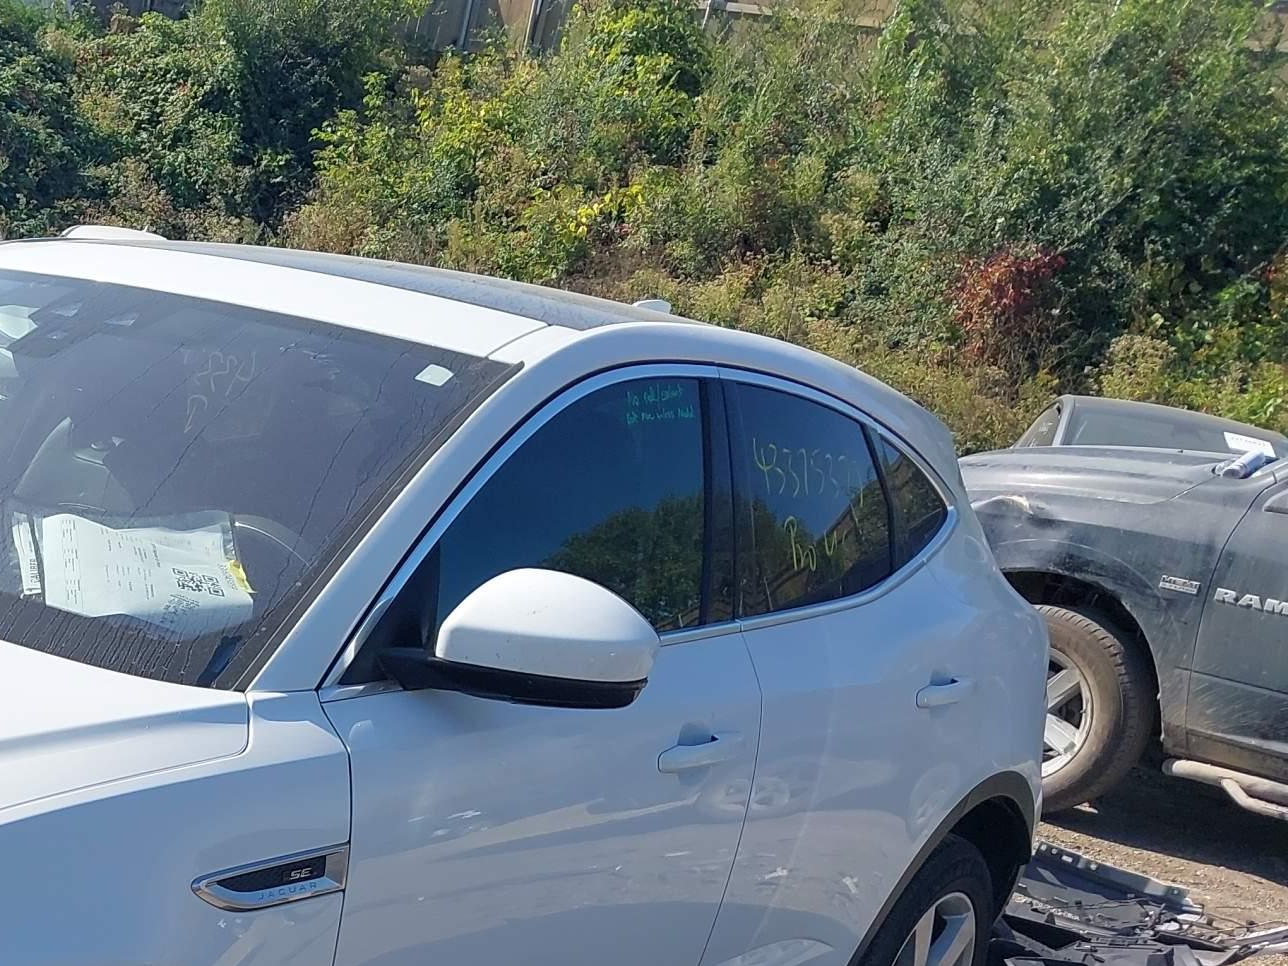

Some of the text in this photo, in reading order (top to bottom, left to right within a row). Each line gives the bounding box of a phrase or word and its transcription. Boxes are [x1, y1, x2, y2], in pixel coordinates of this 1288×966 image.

[1214, 587, 1288, 616] RAM
[289, 867, 312, 880] SE
[258, 882, 318, 900] JAGUAR
